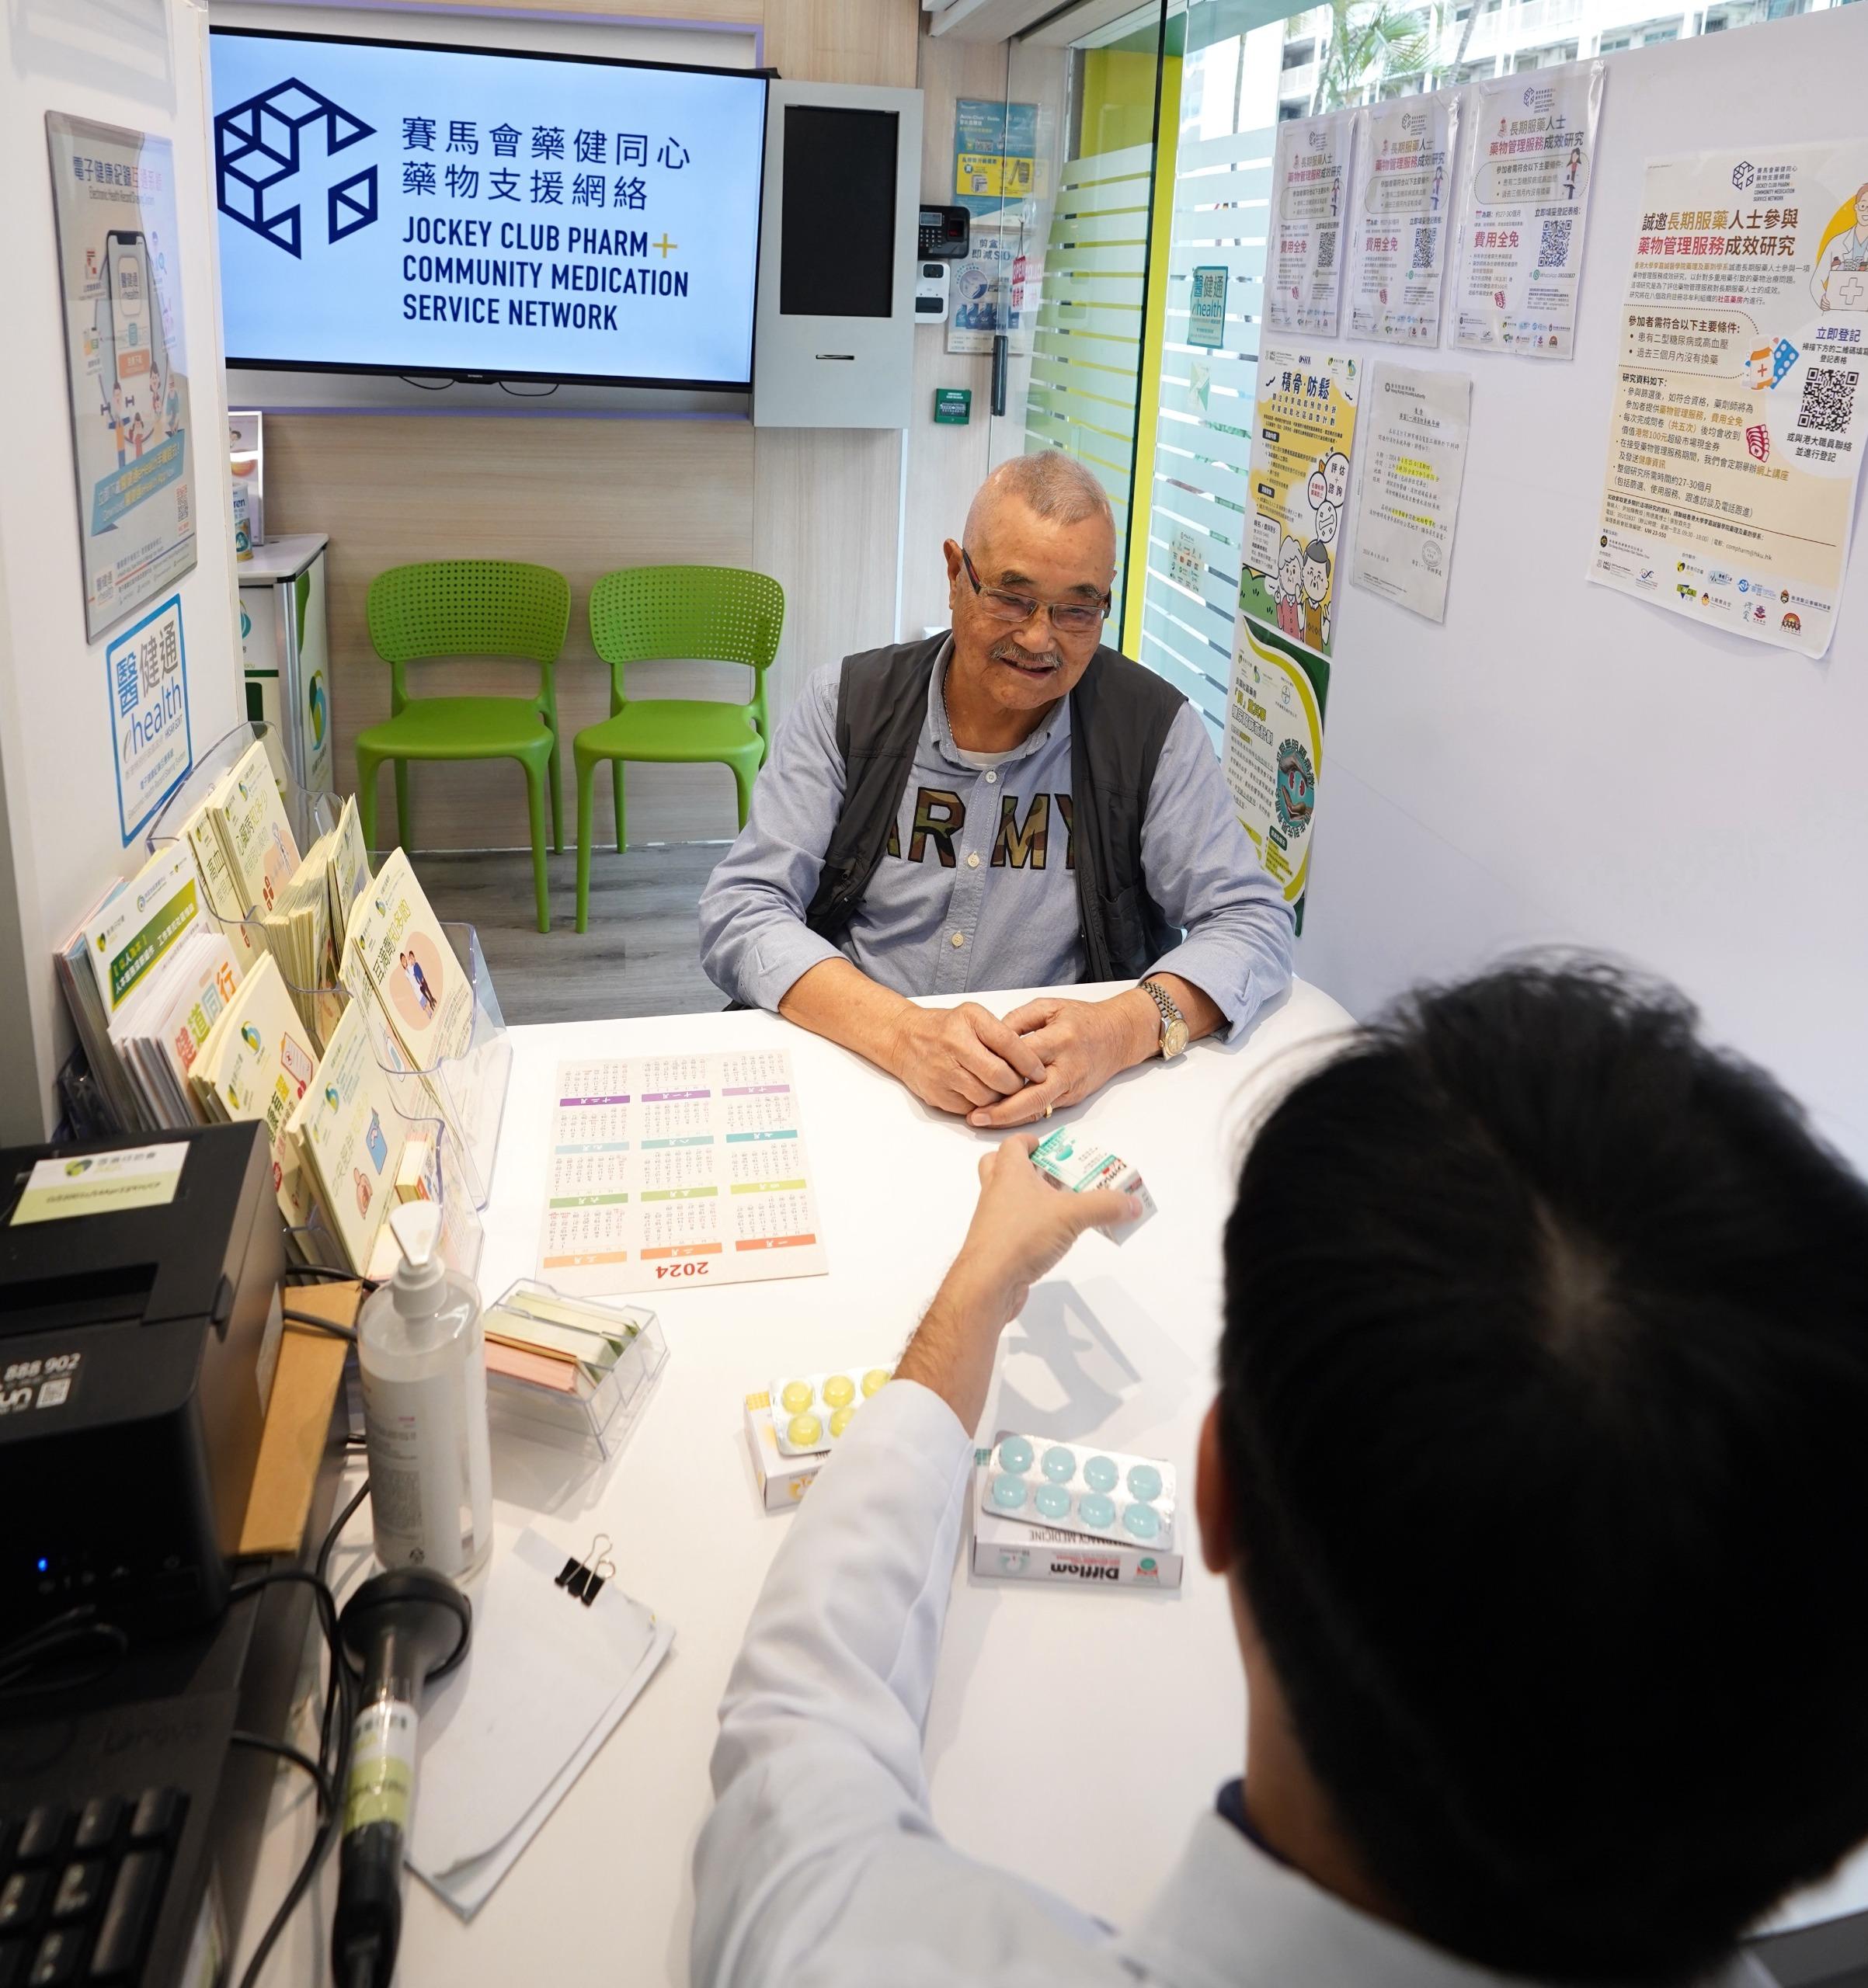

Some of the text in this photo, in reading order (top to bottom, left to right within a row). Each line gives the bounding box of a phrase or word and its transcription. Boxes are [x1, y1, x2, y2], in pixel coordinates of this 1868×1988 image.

[1510, 115, 1566, 136] 長期服藥人士
[402, 116, 690, 169] 賽馬會藥健同心
[1489, 131, 1584, 155] 藥物管理服務成效研究
[402, 162, 647, 210] 藥物支援網絡
[1642, 209, 1798, 231] 誠邀長期服藥人士參與
[403, 216, 492, 247] JOCKEY
[501, 223, 559, 252] CLUB
[1474, 231, 1519, 248] 費用全免
[1365, 237, 1398, 252] 費用全免
[1637, 235, 1796, 257] 藥物管理服務成效研究
[403, 255, 688, 297] COMMUNITY MEDICATION
[1194, 275, 1223, 298] 醫健通
[403, 294, 617, 331] SERVICE NETWORK
[1638, 332, 1729, 351] 患有二型糖尿病或高血壓
[1816, 326, 1861, 343] 立即登記
[1637, 347, 1719, 367] 過去三個月內沒有換藥
[1820, 354, 1848, 364] 登記表格
[1786, 432, 1853, 453] 或與港大職員聯絡
[1619, 451, 1666, 469] 及發送健康資訊
[1795, 446, 1837, 463] 並進行登記
[1331, 462, 1345, 476] 評估
[1328, 483, 1343, 497] 諮詢
[1653, 530, 1667, 538] 23-550
[117, 620, 179, 718] 醫健通
[123, 676, 182, 764] ehealth
[671, 1247, 694, 1256] 二月
[766, 1239, 788, 1248] 一月
[574, 1256, 597, 1264] 三月
[655, 1261, 709, 1279] 2024
[44, 1353, 81, 1375] 902
[1029, 1527, 1077, 1544] MEDICINE
[1050, 1563, 1119, 1580] Difflam
